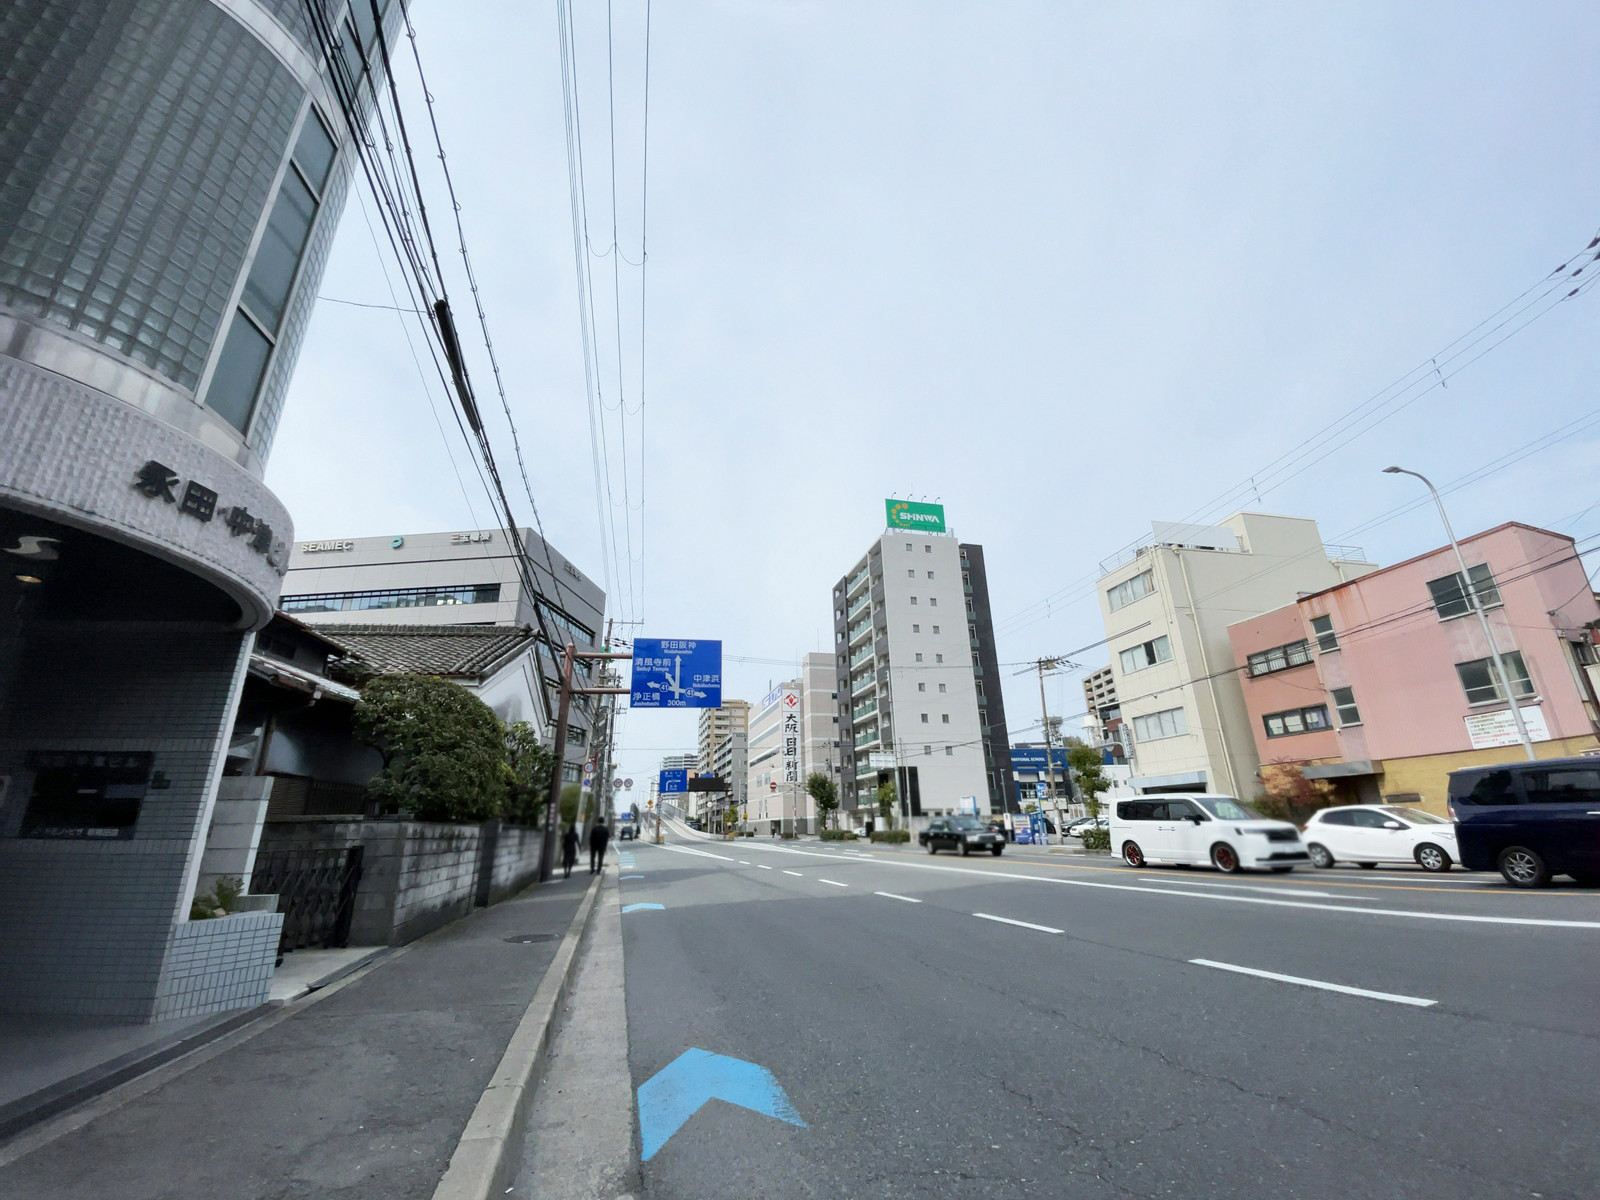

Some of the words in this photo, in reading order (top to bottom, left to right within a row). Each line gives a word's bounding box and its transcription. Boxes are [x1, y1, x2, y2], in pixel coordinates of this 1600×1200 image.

[300, 540, 353, 553] SEAMEC
[661, 641, 696, 649] 野田阪神
[635, 657, 671, 666] 清風寺前
[694, 674, 719, 683] 中津浜
[633, 692, 660, 701] 浄正橋
